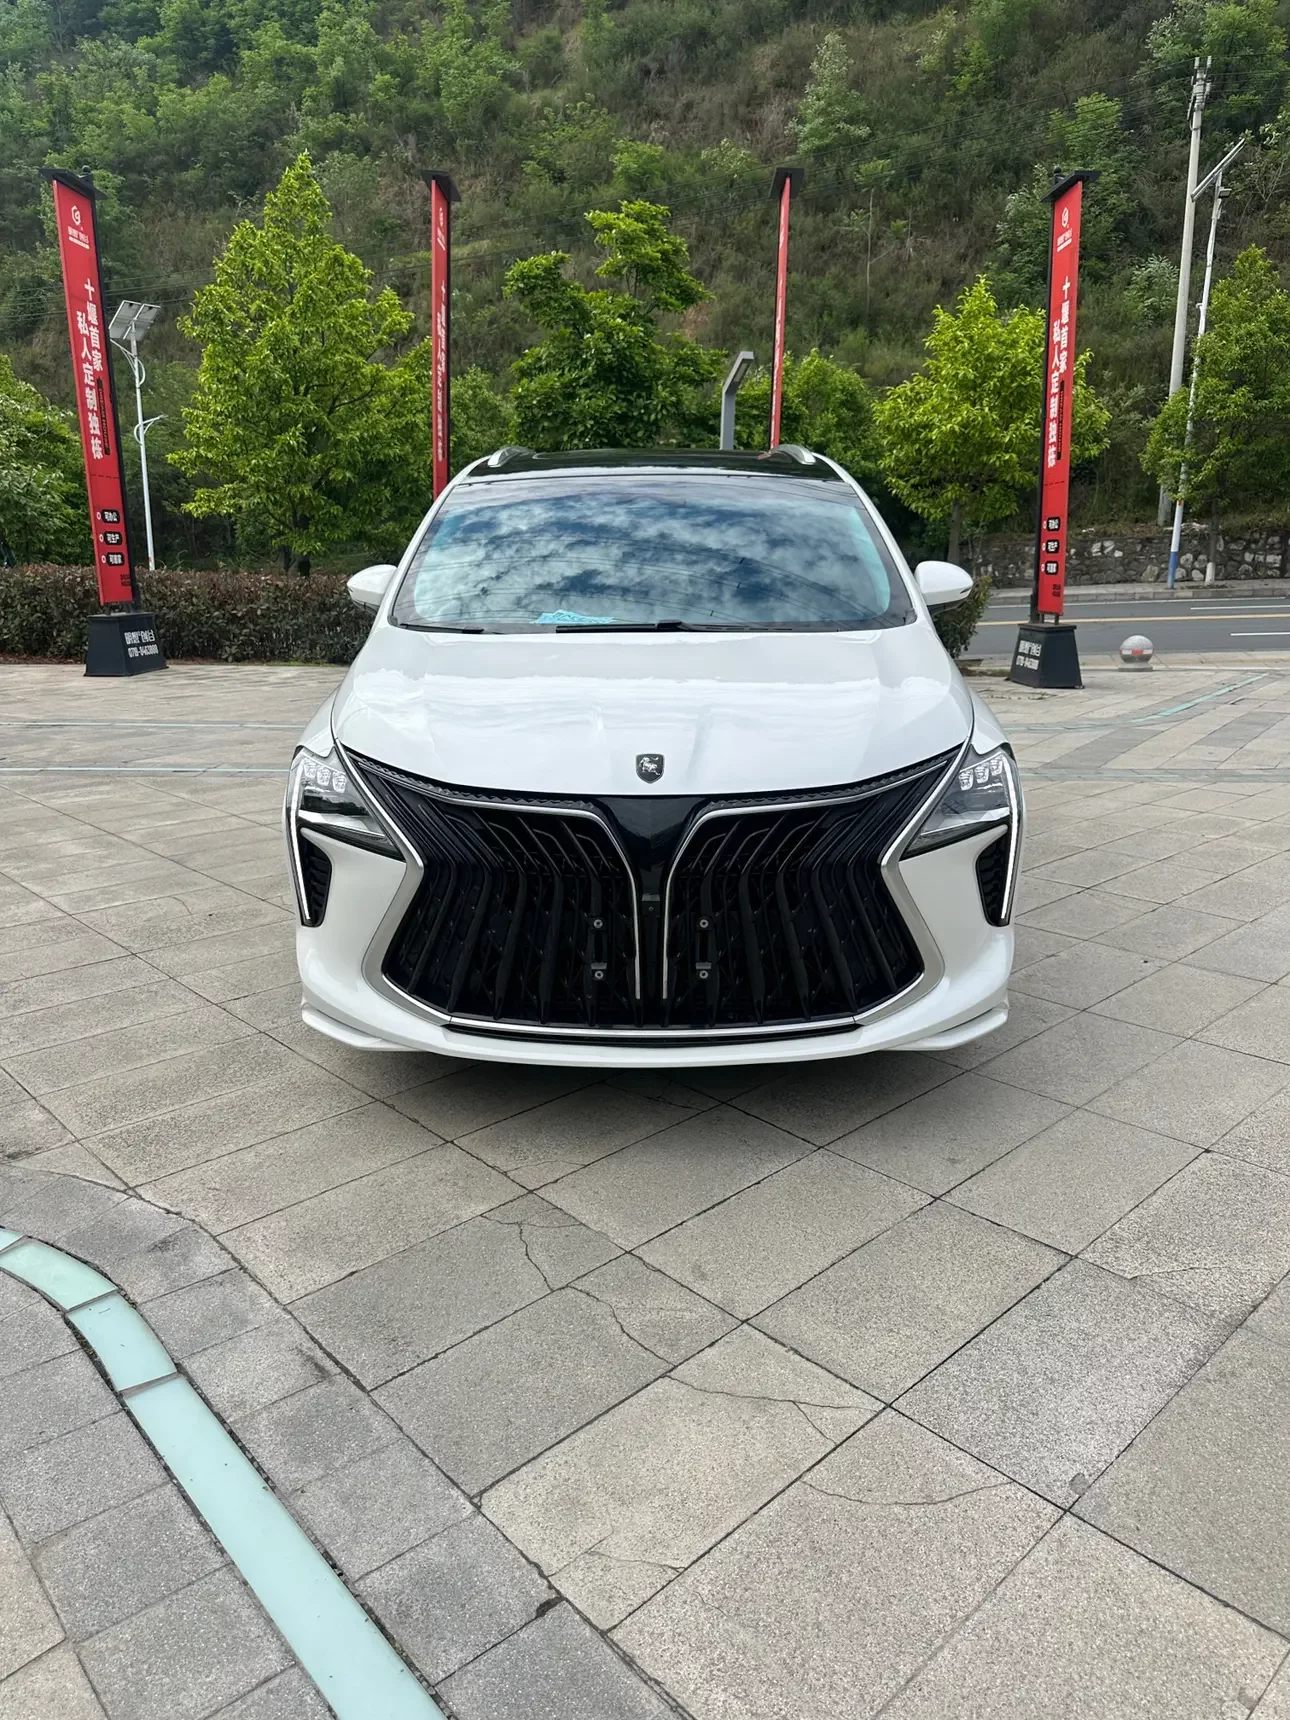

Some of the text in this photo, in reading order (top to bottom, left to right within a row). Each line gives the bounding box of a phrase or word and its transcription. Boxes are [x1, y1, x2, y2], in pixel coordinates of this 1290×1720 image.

[76, 310, 103, 459] 私人定制独栋
[84, 278, 103, 371] 十堰首家
